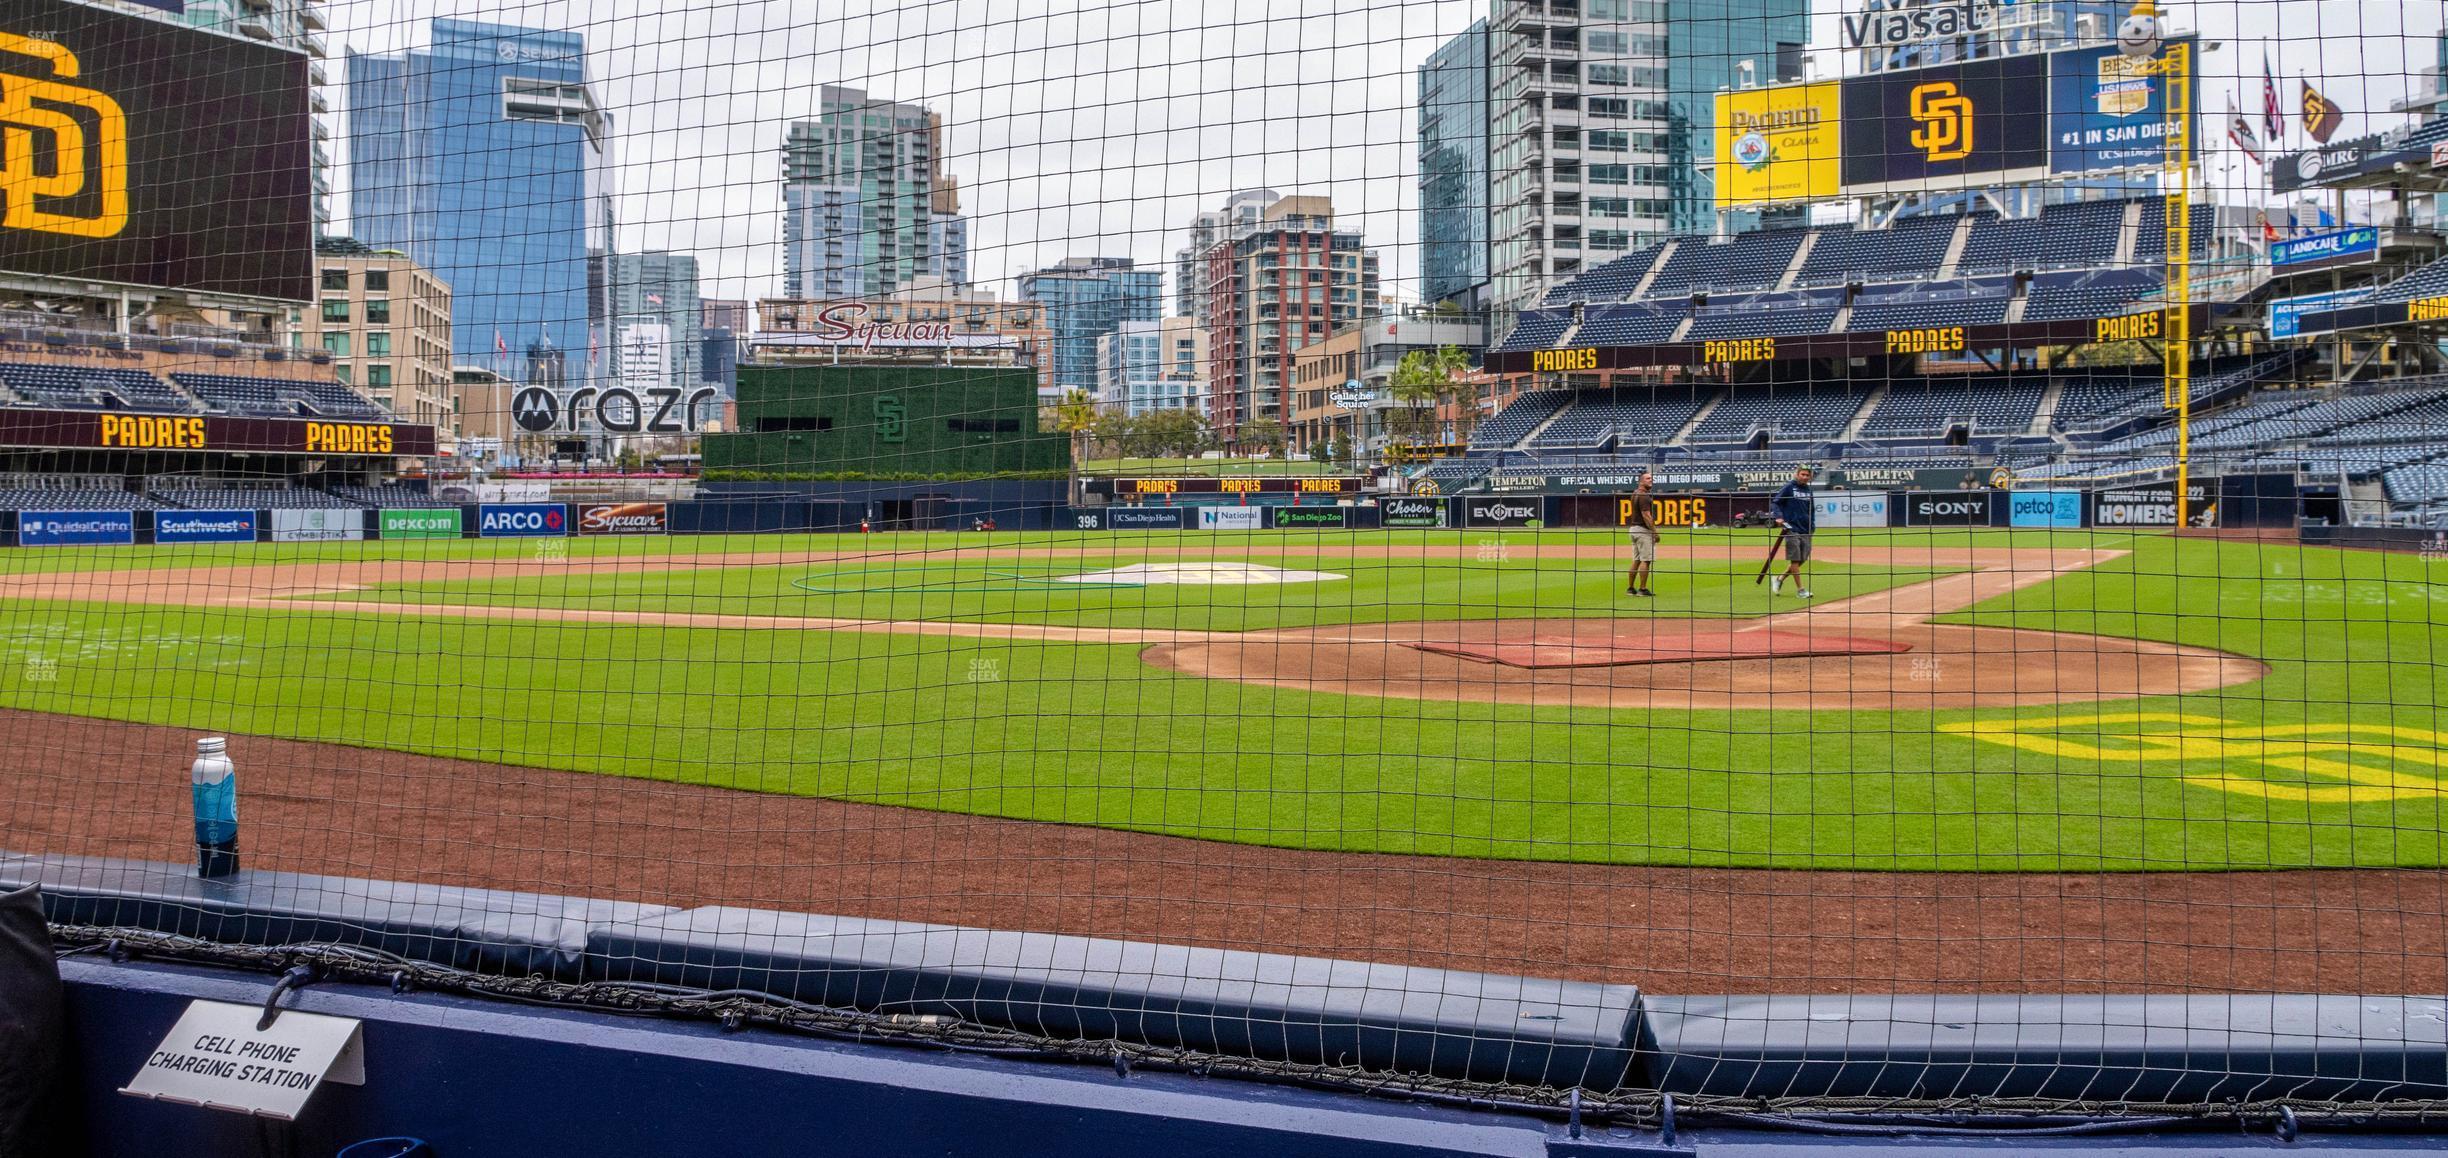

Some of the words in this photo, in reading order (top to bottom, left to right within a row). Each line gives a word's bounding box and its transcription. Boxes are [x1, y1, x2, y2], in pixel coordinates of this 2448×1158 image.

[1844, 3, 1982, 46] Viasat
[2102, 56, 2134, 72] BES
[2062, 132, 2080, 145] #1
[2086, 130, 2101, 144] IN
[2106, 125, 2136, 141] SAN
[2142, 120, 2183, 138] DIEGO
[817, 302, 956, 352] Sycuan
[2097, 312, 2159, 342] PADRES
[1888, 327, 1964, 353] PADRES
[1704, 338, 1775, 362] PADRES
[1533, 348, 1598, 371] PADRES
[1330, 391, 1376, 402] Gallagher
[567, 385, 718, 433] razr
[1336, 400, 1369, 409] Square
[101, 414, 205, 448] PADRES
[306, 422, 393, 453] PADRES
[1489, 476, 1547, 486] TEMPLETON
[1560, 476, 1597, 486] OFFICIAL
[1597, 475, 1634, 485] WHISKEY
[1652, 474, 1667, 484] SAN
[1669, 474, 1690, 484] DIEGO
[1692, 473, 1721, 483] PADRES
[1735, 472, 1795, 483] TEMPLETO
[1844, 470, 1915, 481] TEMPLETON
[1136, 480, 1177, 492] PADRES
[1221, 479, 1261, 492] PADRES
[1302, 479, 1341, 491] PADRES
[2104, 490, 2149, 502] HUNGRY
[2150, 490, 2173, 502] FOR
[1386, 500, 1433, 514] Chosen
[1474, 504, 1535, 521] EVOTEK
[1619, 499, 1706, 526] PDRES
[1919, 502, 1983, 515] SONY
[2014, 498, 2054, 518] petco
[2099, 504, 2178, 524] HOMERS
[483, 512, 543, 529] ARCO
[584, 506, 658, 533] Sycuan
[1078, 515, 1098, 529] 396
[1114, 514, 1125, 522] UC
[1125, 514, 1137, 522] San
[1138, 514, 1155, 523] Diego
[1156, 514, 1176, 522] Health
[1221, 511, 1257, 519] National
[1292, 513, 1305, 521] San
[1306, 513, 1326, 522] Diego
[1327, 513, 1342, 521] Zoo
[47, 521, 128, 534] QuidelOrtho
[161, 519, 239, 533] Southwest
[287, 531, 349, 539] CYMBIOTIKA
[194, 1035, 236, 1055] CELL
[238, 1041, 300, 1063] PHONE
[149, 1051, 237, 1079] CHARGING
[238, 1065, 316, 1090] STATION
